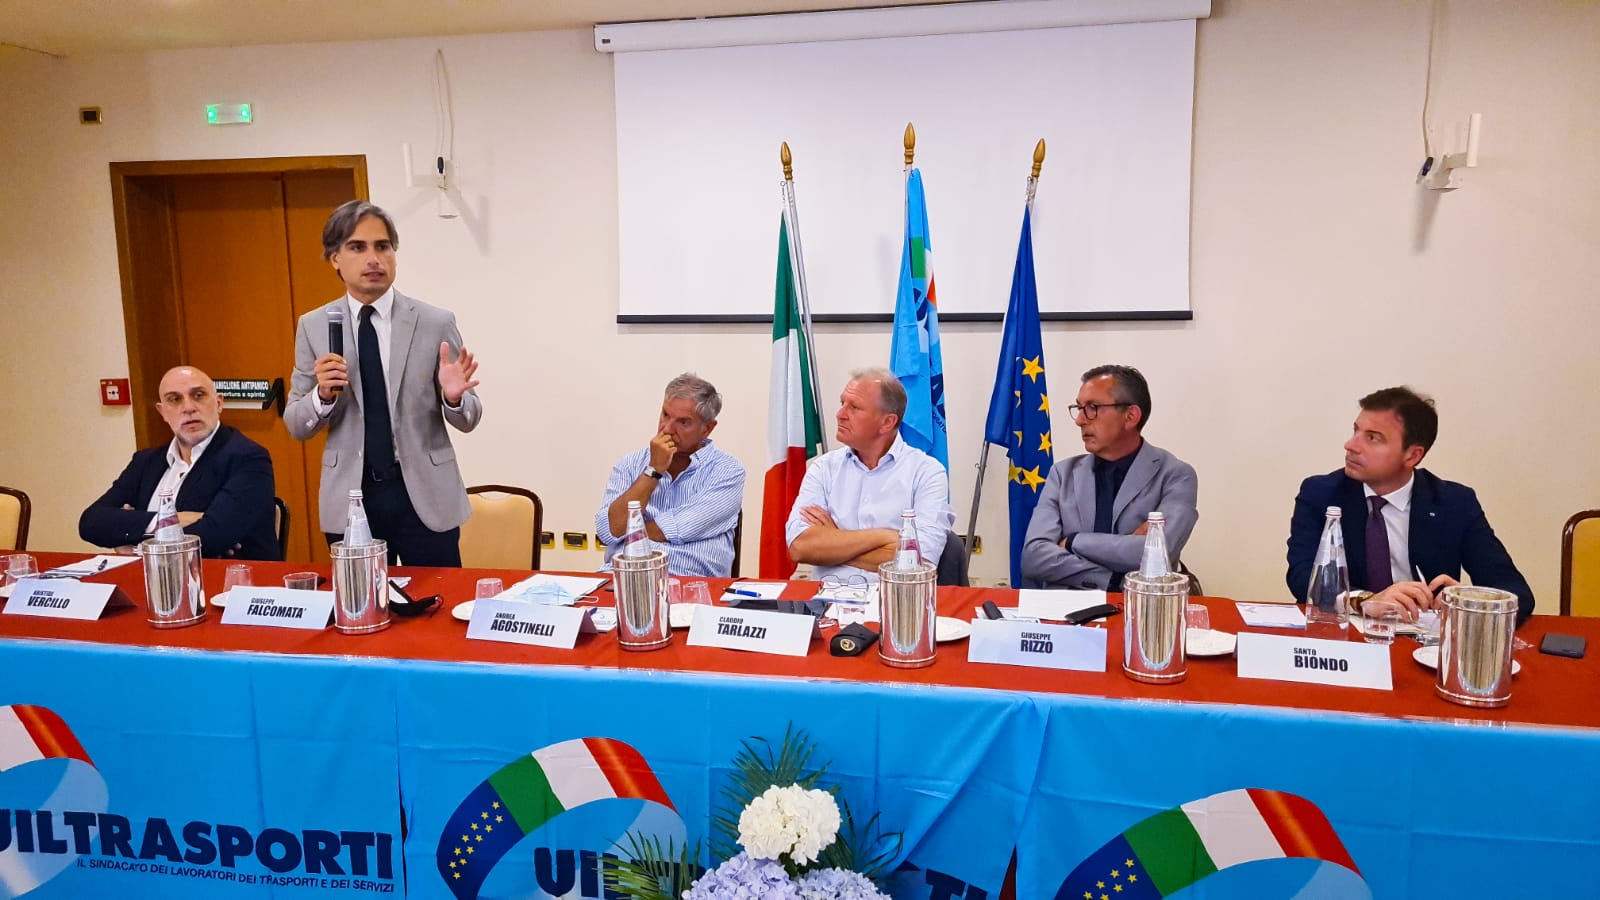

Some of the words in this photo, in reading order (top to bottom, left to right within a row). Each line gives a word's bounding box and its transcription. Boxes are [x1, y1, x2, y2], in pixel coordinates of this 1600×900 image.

[27, 596, 70, 608] VERCILLO
[719, 616, 743, 624] CLAUDIO
[490, 619, 555, 636] AGOSTINELLI
[717, 623, 767, 639] TARLAZZI
[1021, 632, 1051, 640] GIUSEPPE
[1020, 640, 1053, 654] RIZZO
[1294, 647, 1316, 655] SANTO
[1294, 655, 1348, 671] BIONDO
[77, 860, 86, 868] IL
[89, 859, 148, 873] SINDACATO
[150, 863, 168, 875] DEI
[170, 866, 236, 881] LAVORATORI
[238, 873, 256, 884] DEI
[259, 874, 318, 889] TRASPORTI
[321, 879, 327, 888] E
[330, 879, 350, 889] DEI
[352, 879, 394, 893] SERVIZI
